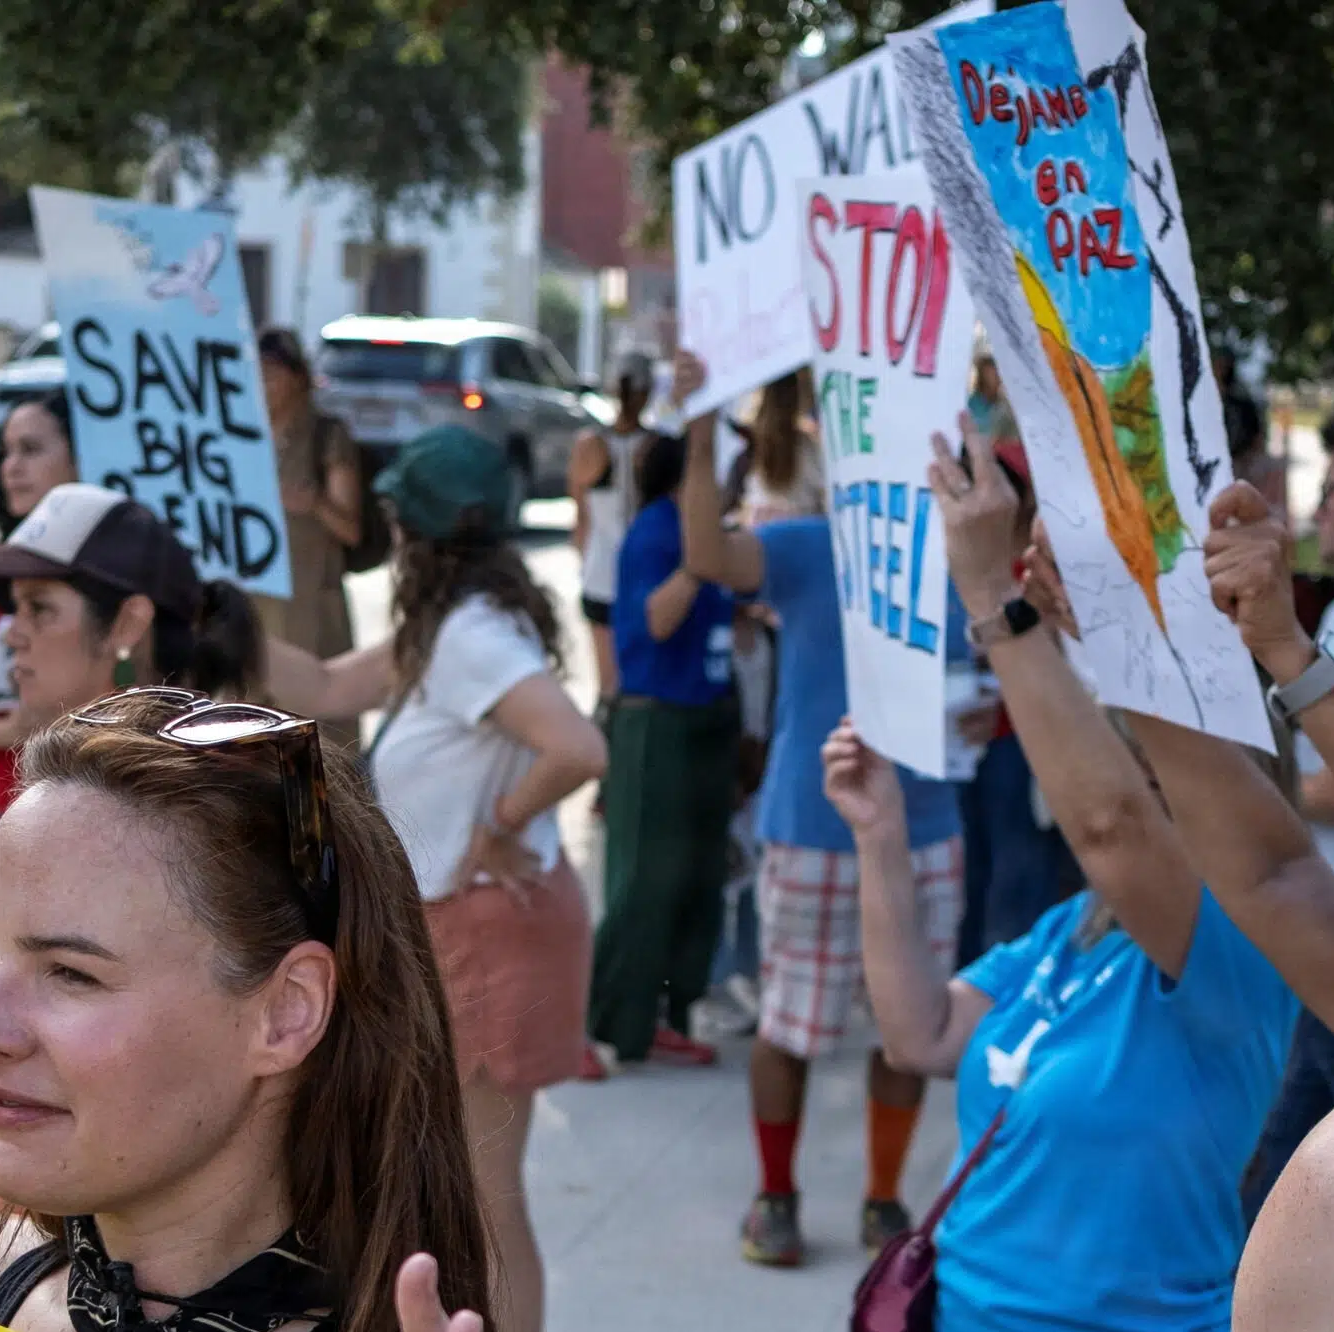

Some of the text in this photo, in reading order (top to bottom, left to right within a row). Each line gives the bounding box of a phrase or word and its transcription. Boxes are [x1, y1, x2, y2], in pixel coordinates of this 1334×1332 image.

[695, 64, 916, 264] NO WAL
[1046, 208, 1137, 277] PAZ
[71, 318, 262, 440] SAVE
[131, 420, 235, 498] BIG
